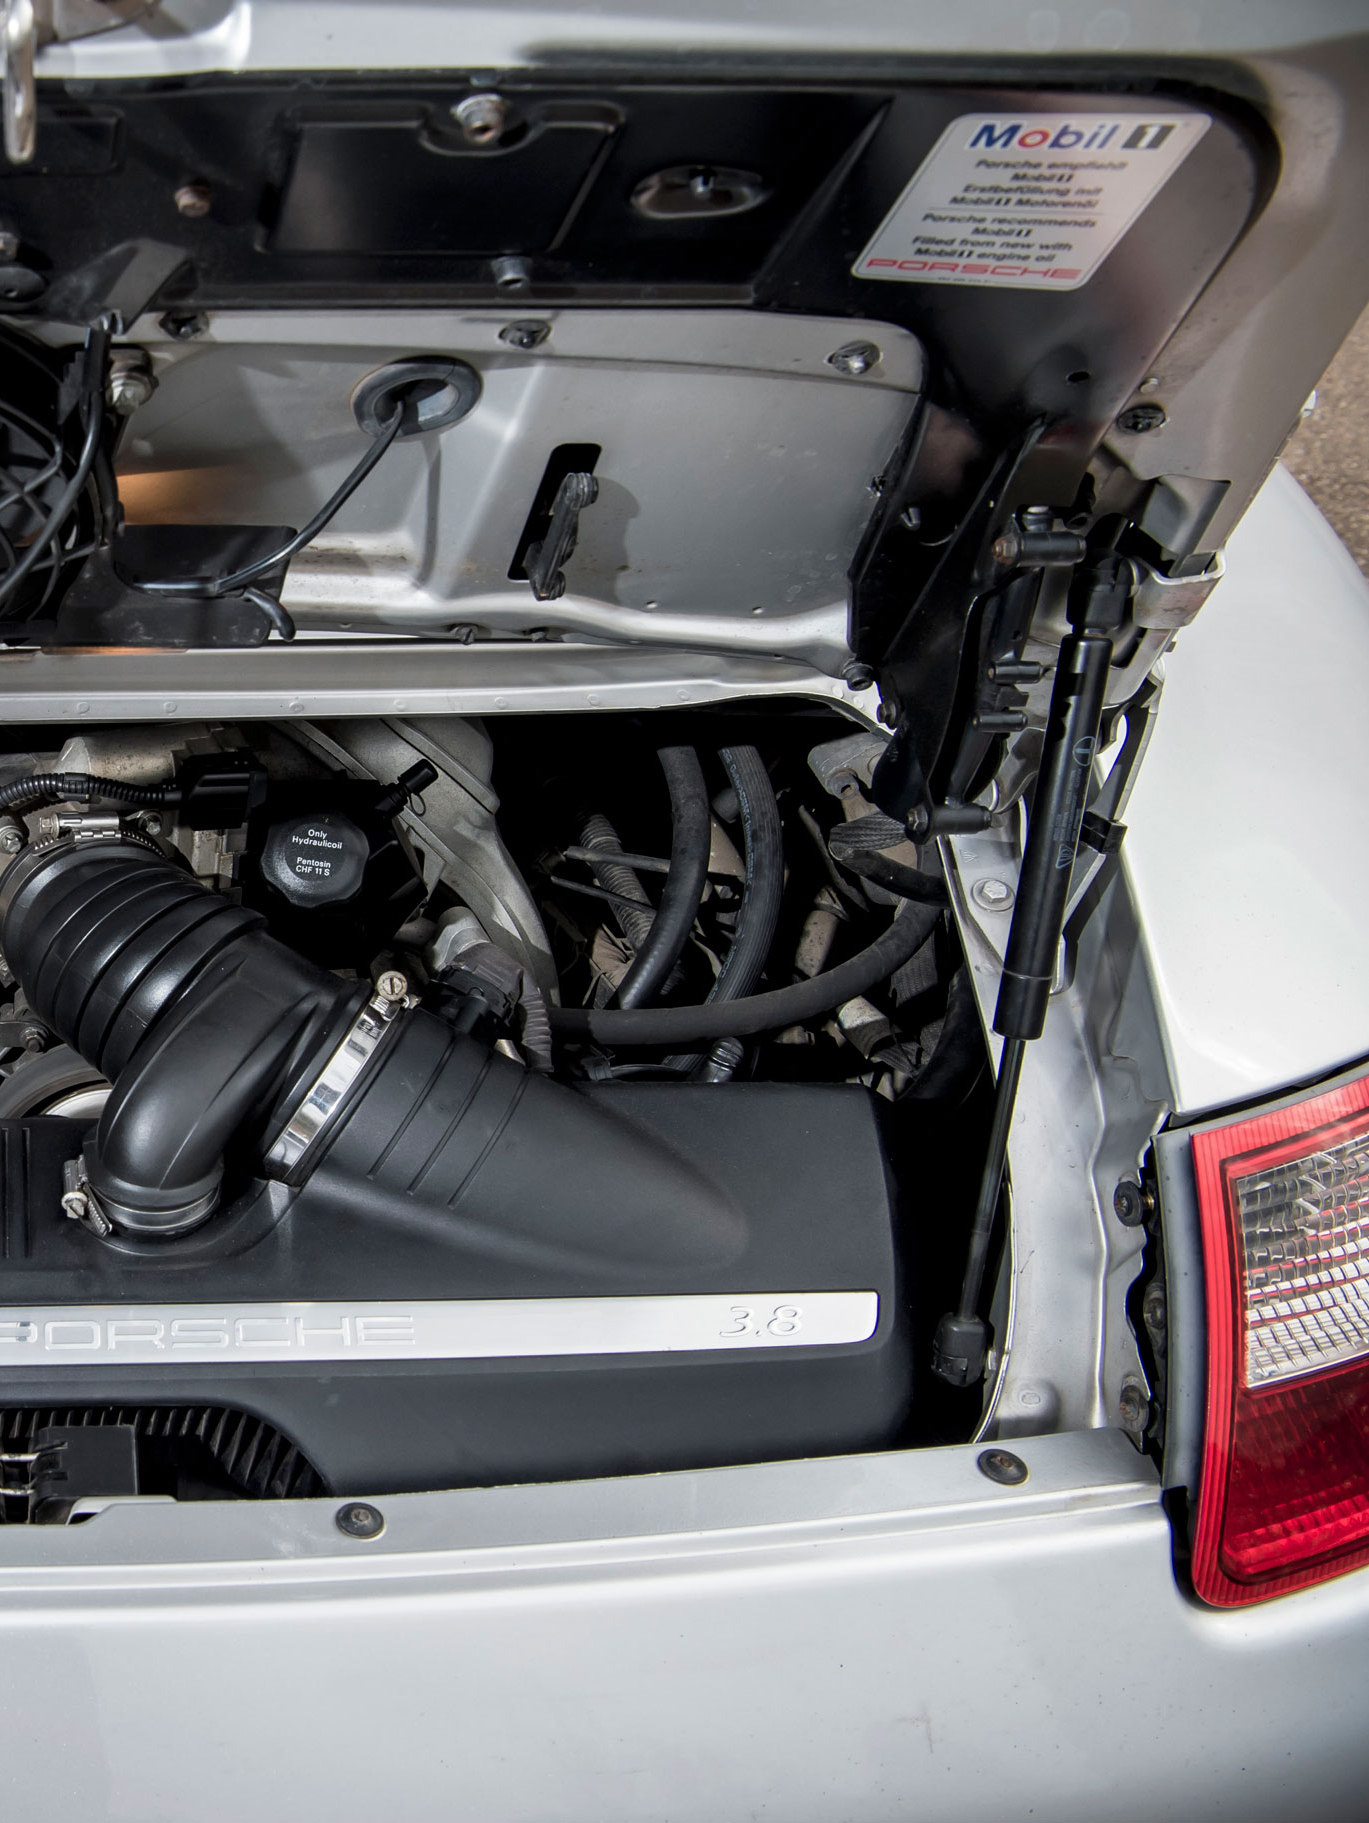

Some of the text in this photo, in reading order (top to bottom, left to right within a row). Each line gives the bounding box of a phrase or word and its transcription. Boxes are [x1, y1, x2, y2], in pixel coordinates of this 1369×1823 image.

[969, 124, 1120, 150] Mobil
[975, 159, 1129, 171] Porsche empfiehlt
[1074, 187, 1103, 196] mit
[1014, 198, 1099, 209] Motorenöl
[921, 213, 1097, 228] Porsche recommends
[912, 235, 1074, 251] Filled from new with
[976, 250, 1031, 263] engine
[1035, 252, 1056, 262] oil
[865, 258, 1083, 281] PORSCHE
[307, 829, 328, 840] Only
[291, 835, 343, 850] Hydraulicoil
[296, 856, 331, 868] Pentosin
[295, 864, 330, 877] CHF 11 S
[718, 1304, 804, 1338] 3.8
